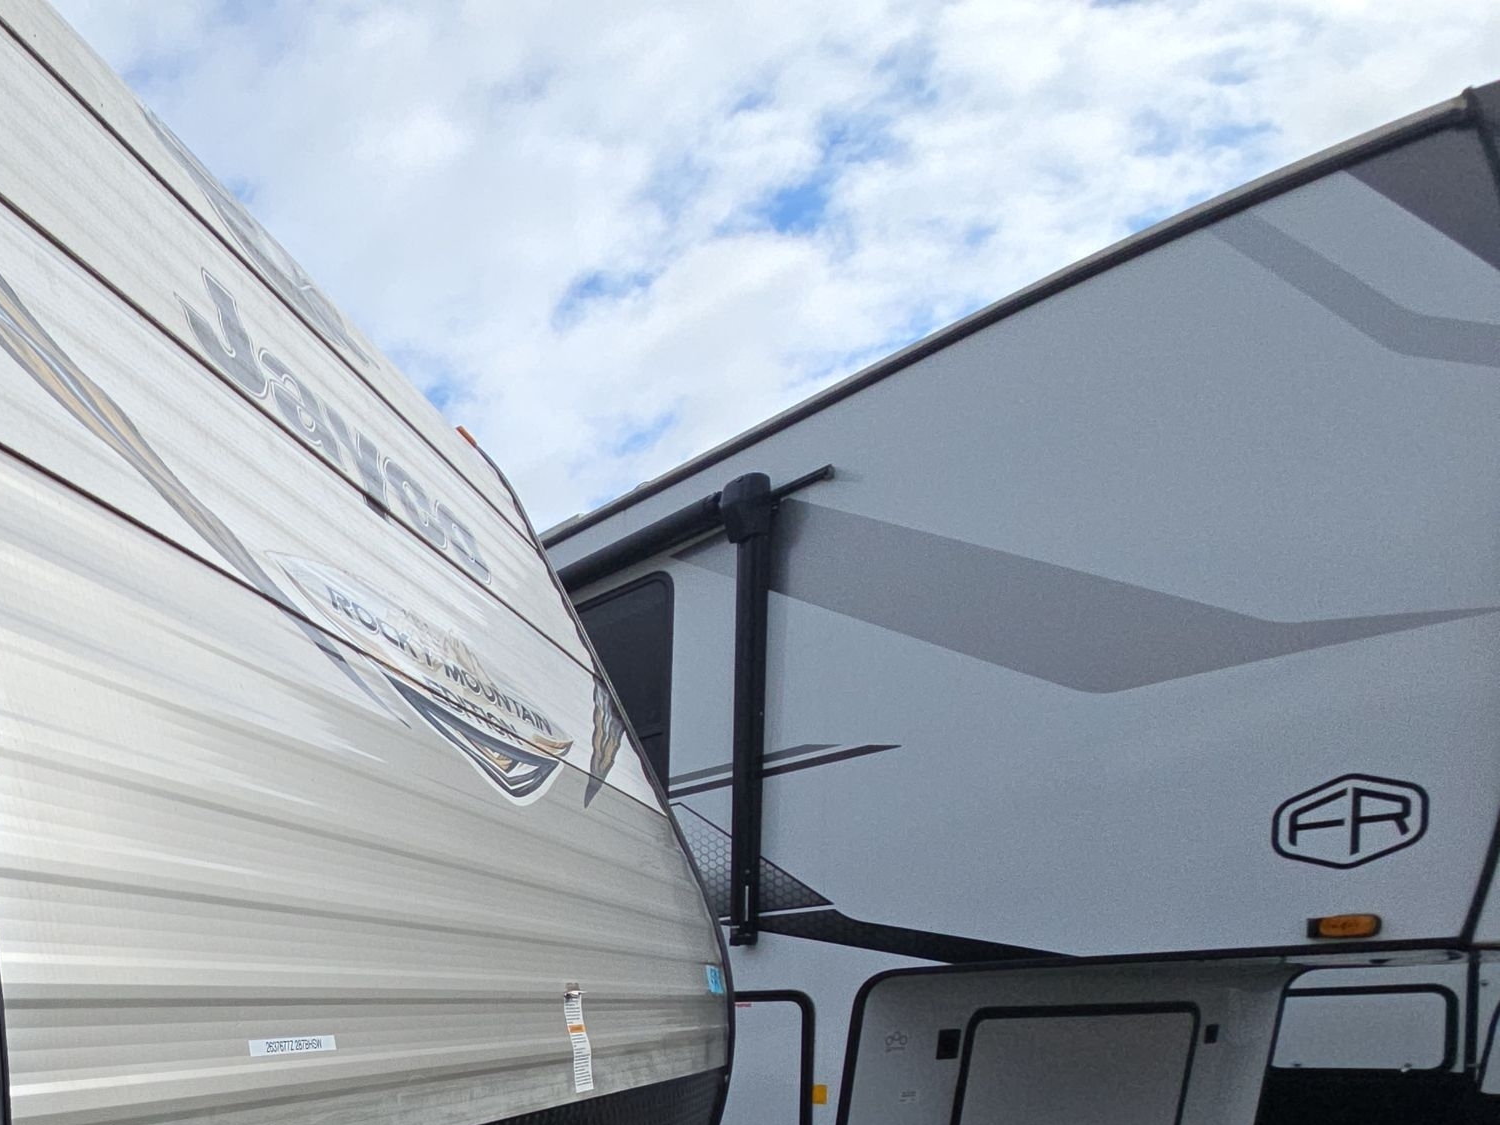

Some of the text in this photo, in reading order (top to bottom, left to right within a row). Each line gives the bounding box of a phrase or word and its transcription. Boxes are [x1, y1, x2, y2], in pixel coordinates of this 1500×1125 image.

[173, 267, 492, 585] Jayco
[323, 585, 553, 737] ROCKY MOUNTAIN
[422, 676, 524, 745] EDITION
